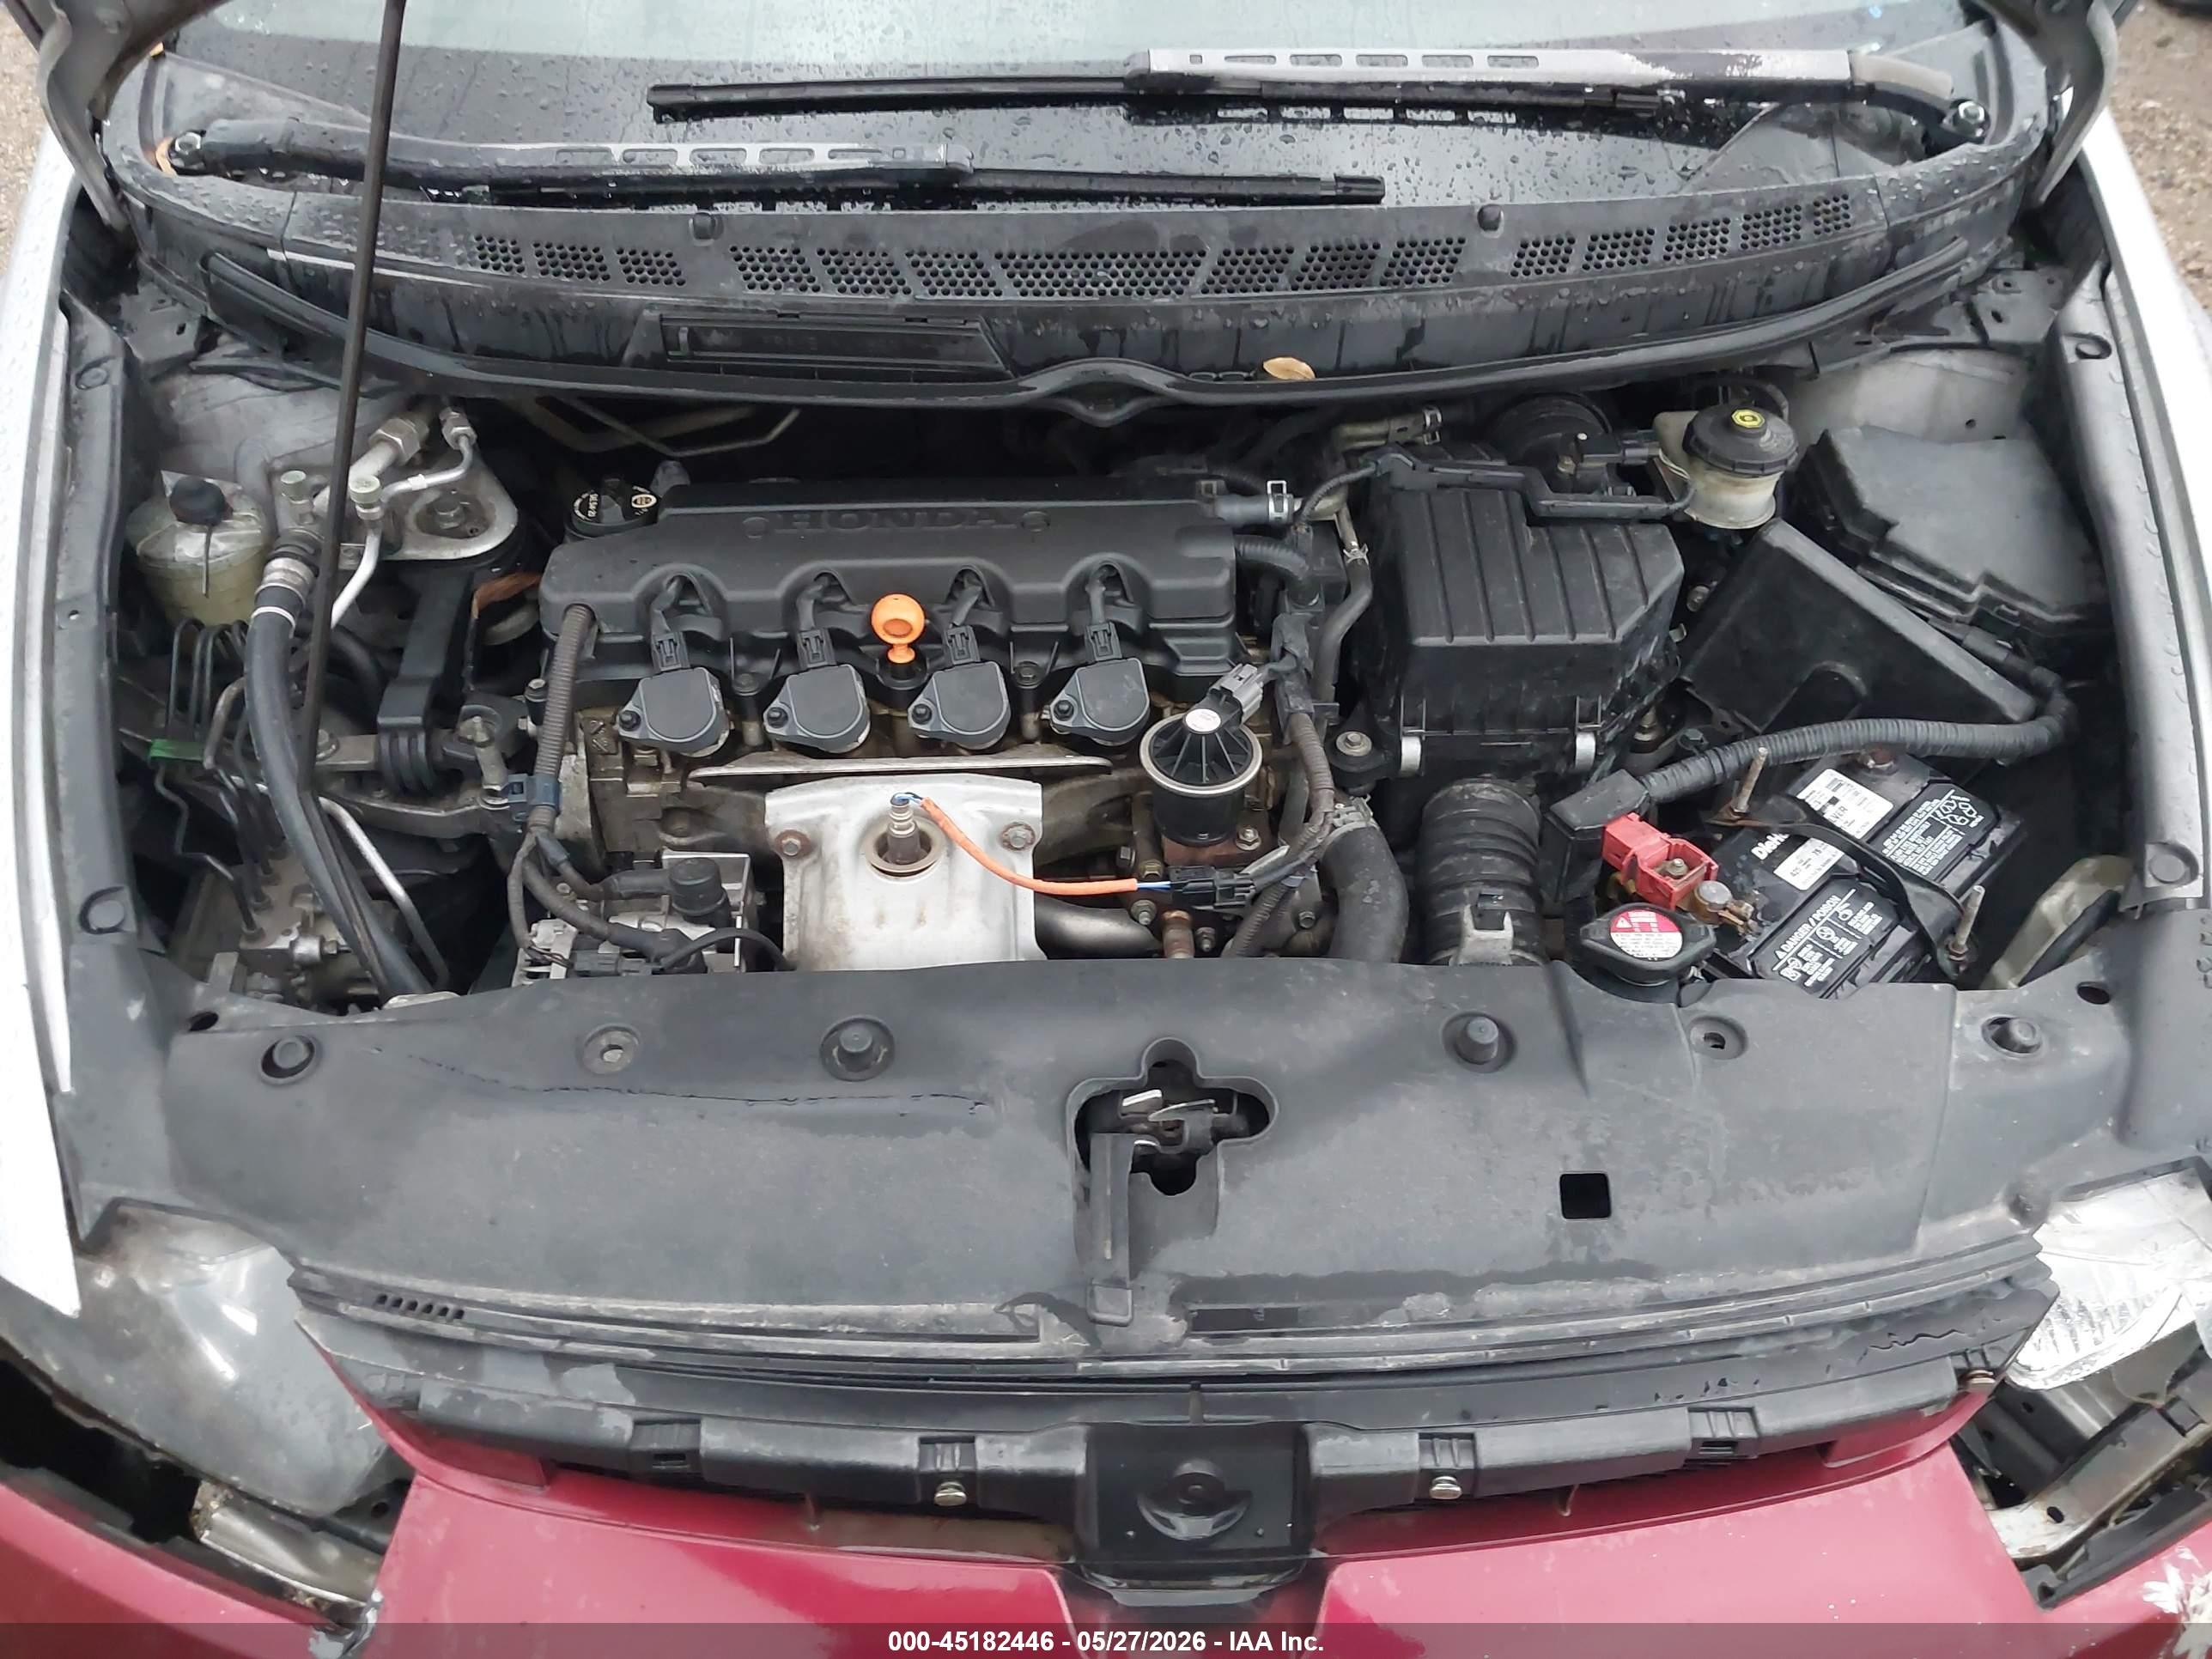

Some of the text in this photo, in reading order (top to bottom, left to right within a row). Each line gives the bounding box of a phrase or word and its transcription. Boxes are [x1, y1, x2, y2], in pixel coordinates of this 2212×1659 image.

[774, 511, 1018, 533] HONDA
[1780, 923, 1814, 952] DANGER
[1812, 895, 1842, 921] POISON
